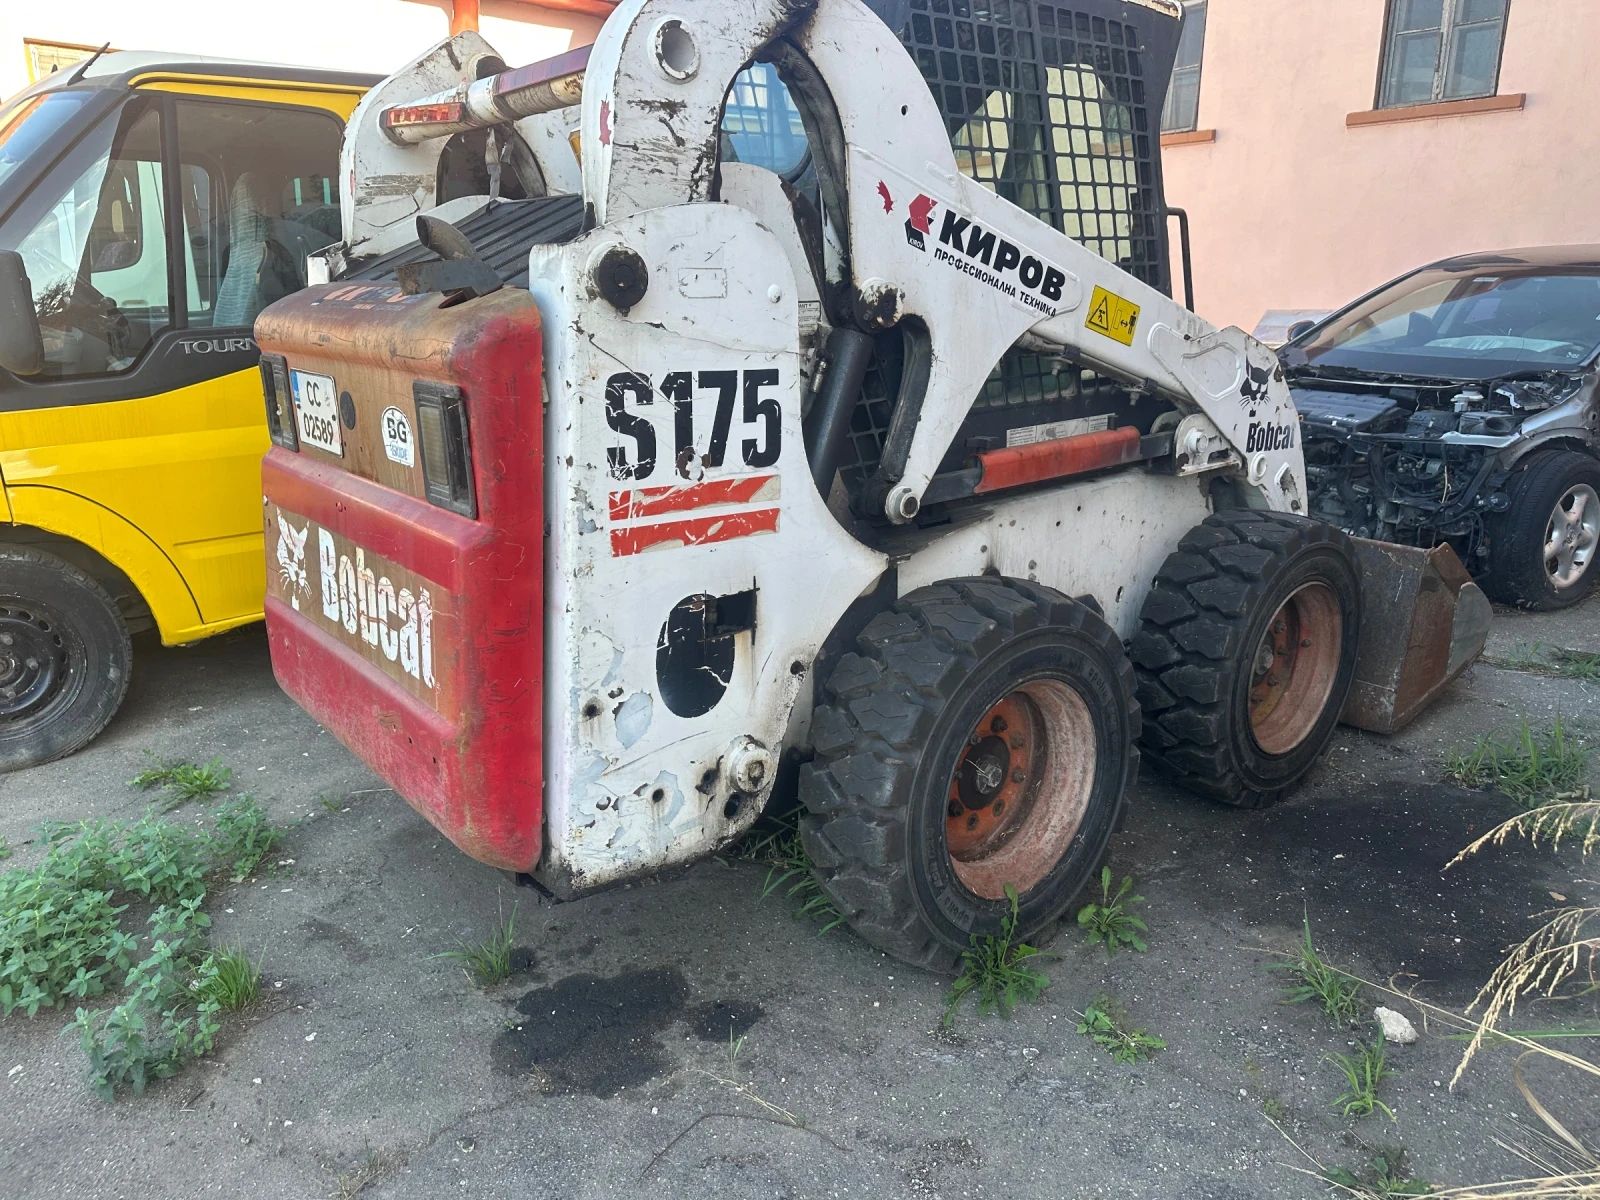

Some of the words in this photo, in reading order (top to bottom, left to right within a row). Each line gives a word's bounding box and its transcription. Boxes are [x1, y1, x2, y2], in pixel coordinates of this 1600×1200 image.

[938, 208, 1066, 302] КИРОВ
[934, 247, 1017, 298] ПРОФЕСИОНАЛНА
[1019, 290, 1057, 317] ТЕХНИКА
[306, 380, 322, 407] CC
[303, 412, 334, 446] 02589
[386, 416, 407, 444] BG
[604, 368, 782, 482] S175
